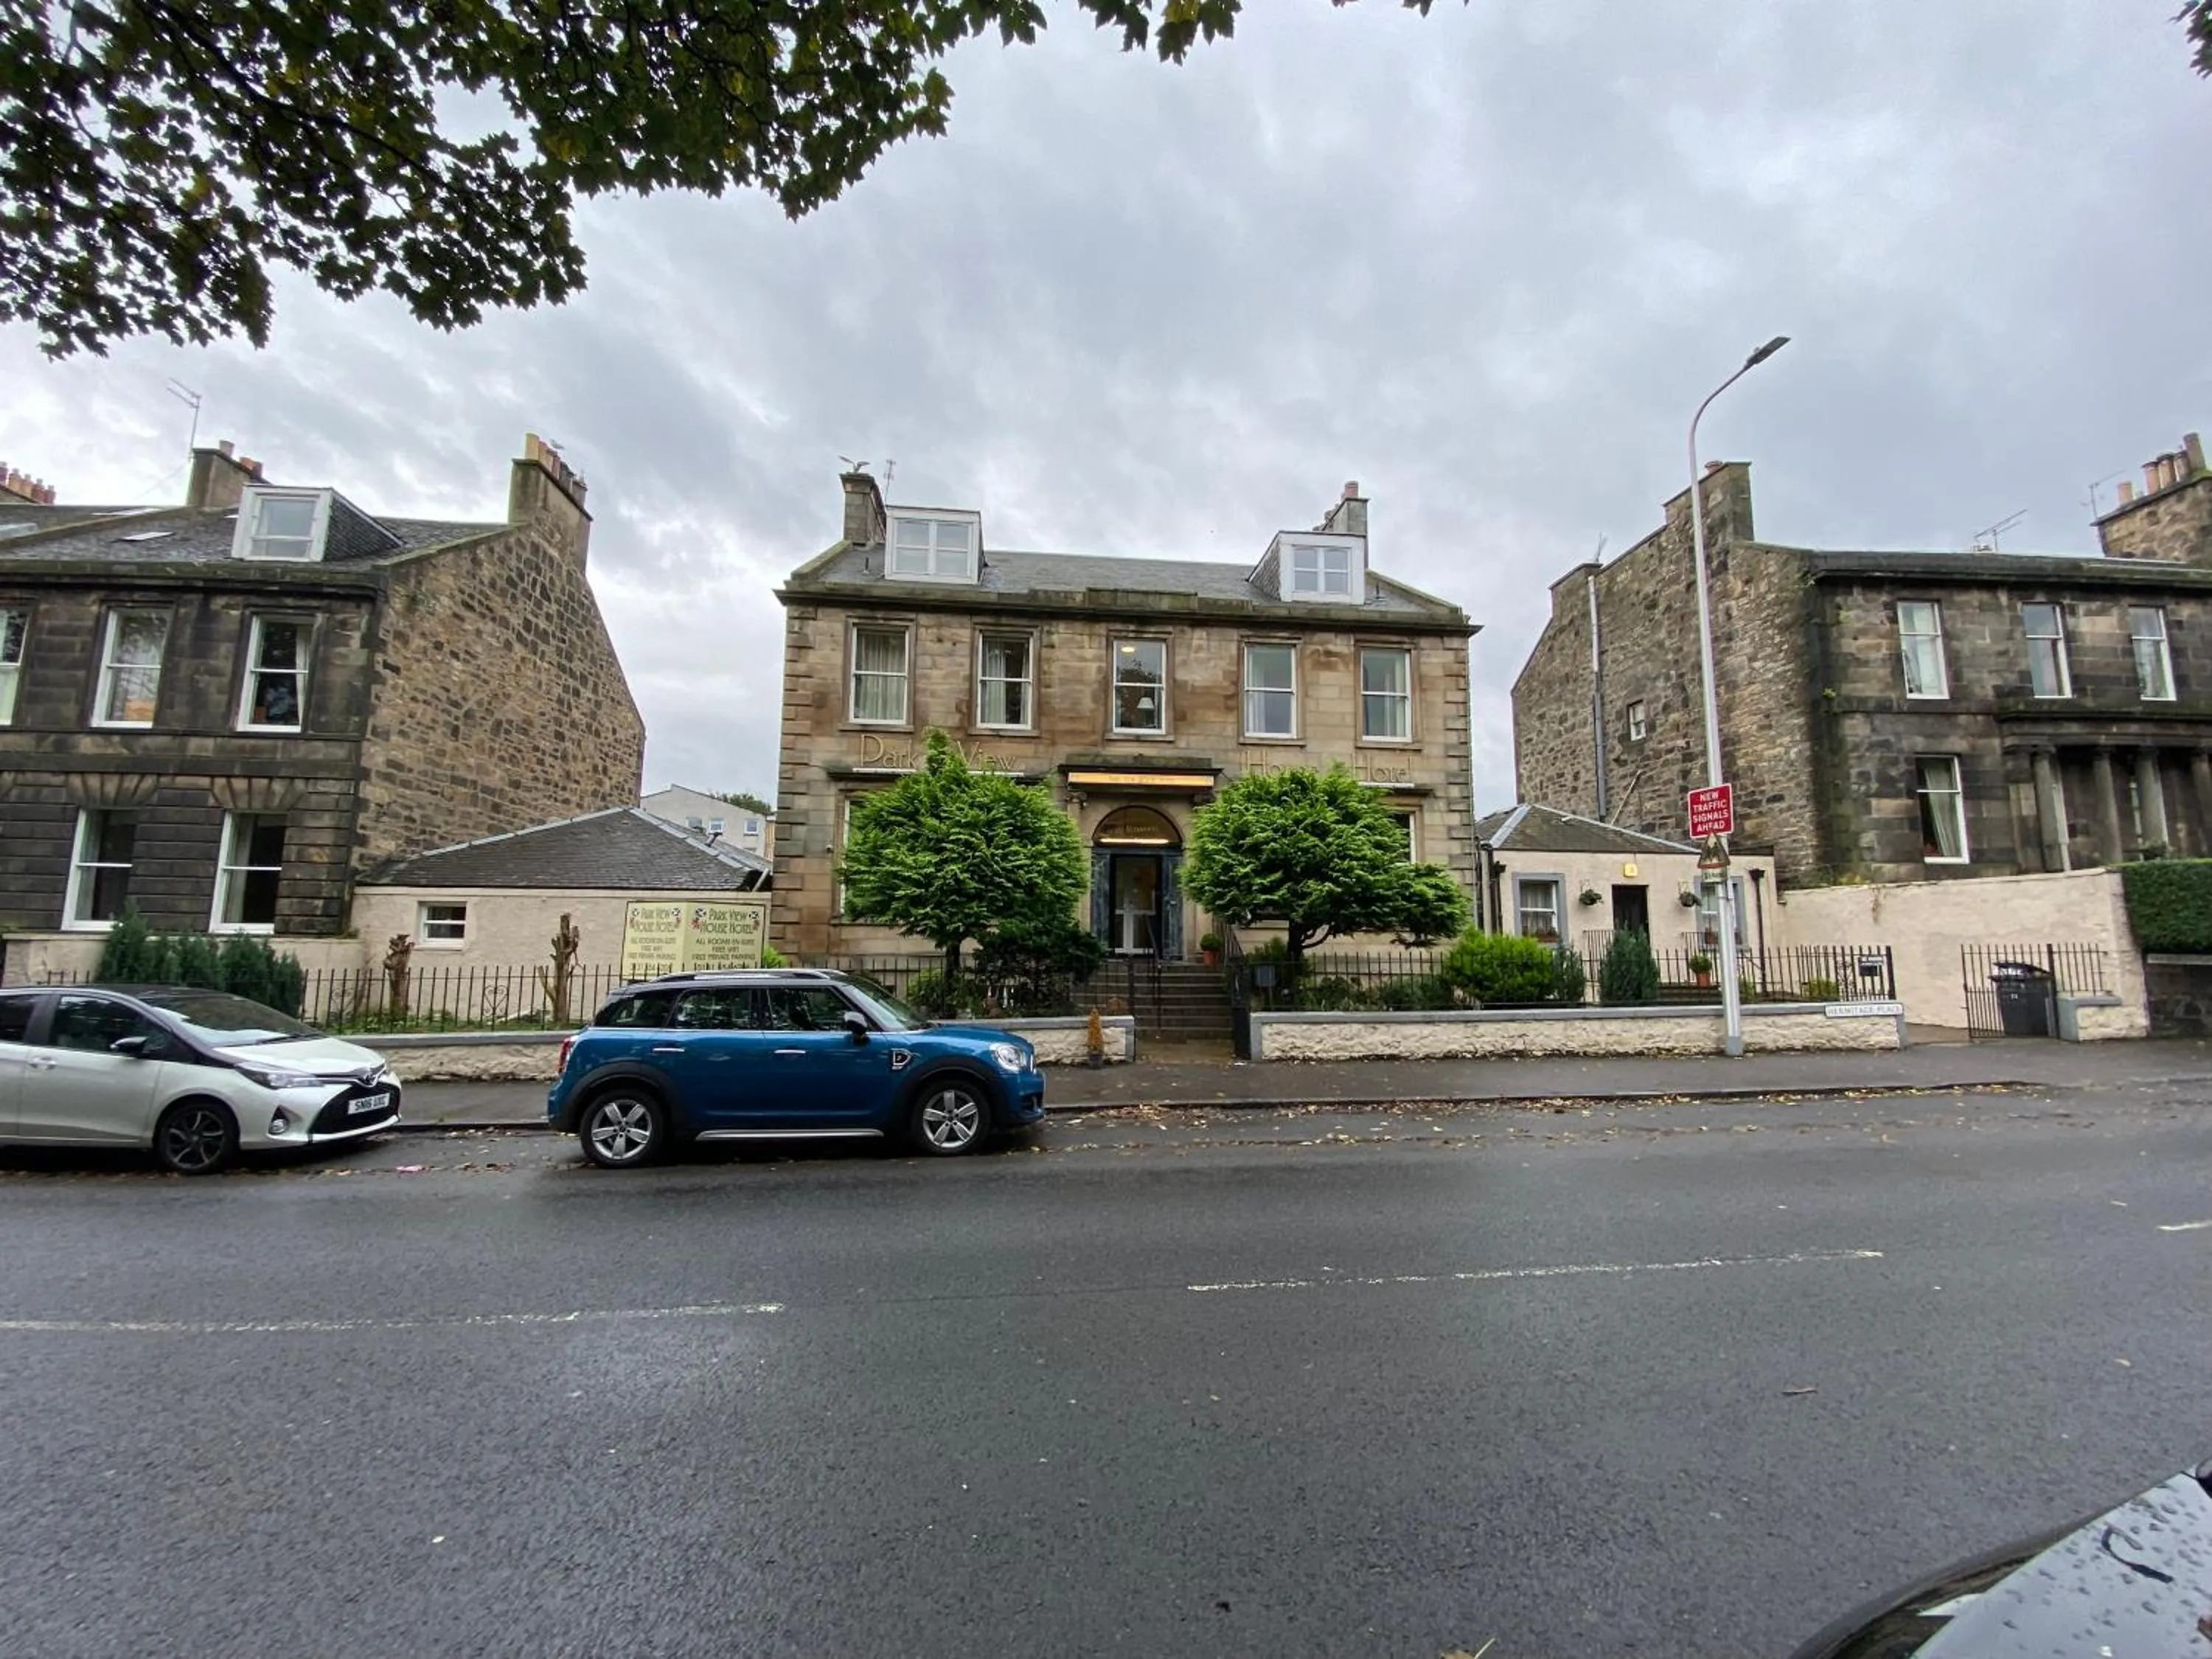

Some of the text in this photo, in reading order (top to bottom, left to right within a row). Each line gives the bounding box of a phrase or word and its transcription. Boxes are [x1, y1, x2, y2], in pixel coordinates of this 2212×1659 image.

[860, 734, 918, 767] Park
[956, 741, 1015, 770] View
[1351, 752, 1413, 782] Hotel
[1700, 791, 1719, 802] NEW
[1693, 800, 1727, 813] TRAFFIC
[1693, 810, 1729, 824] SIGNALS
[1697, 821, 1725, 833] AHEAD
